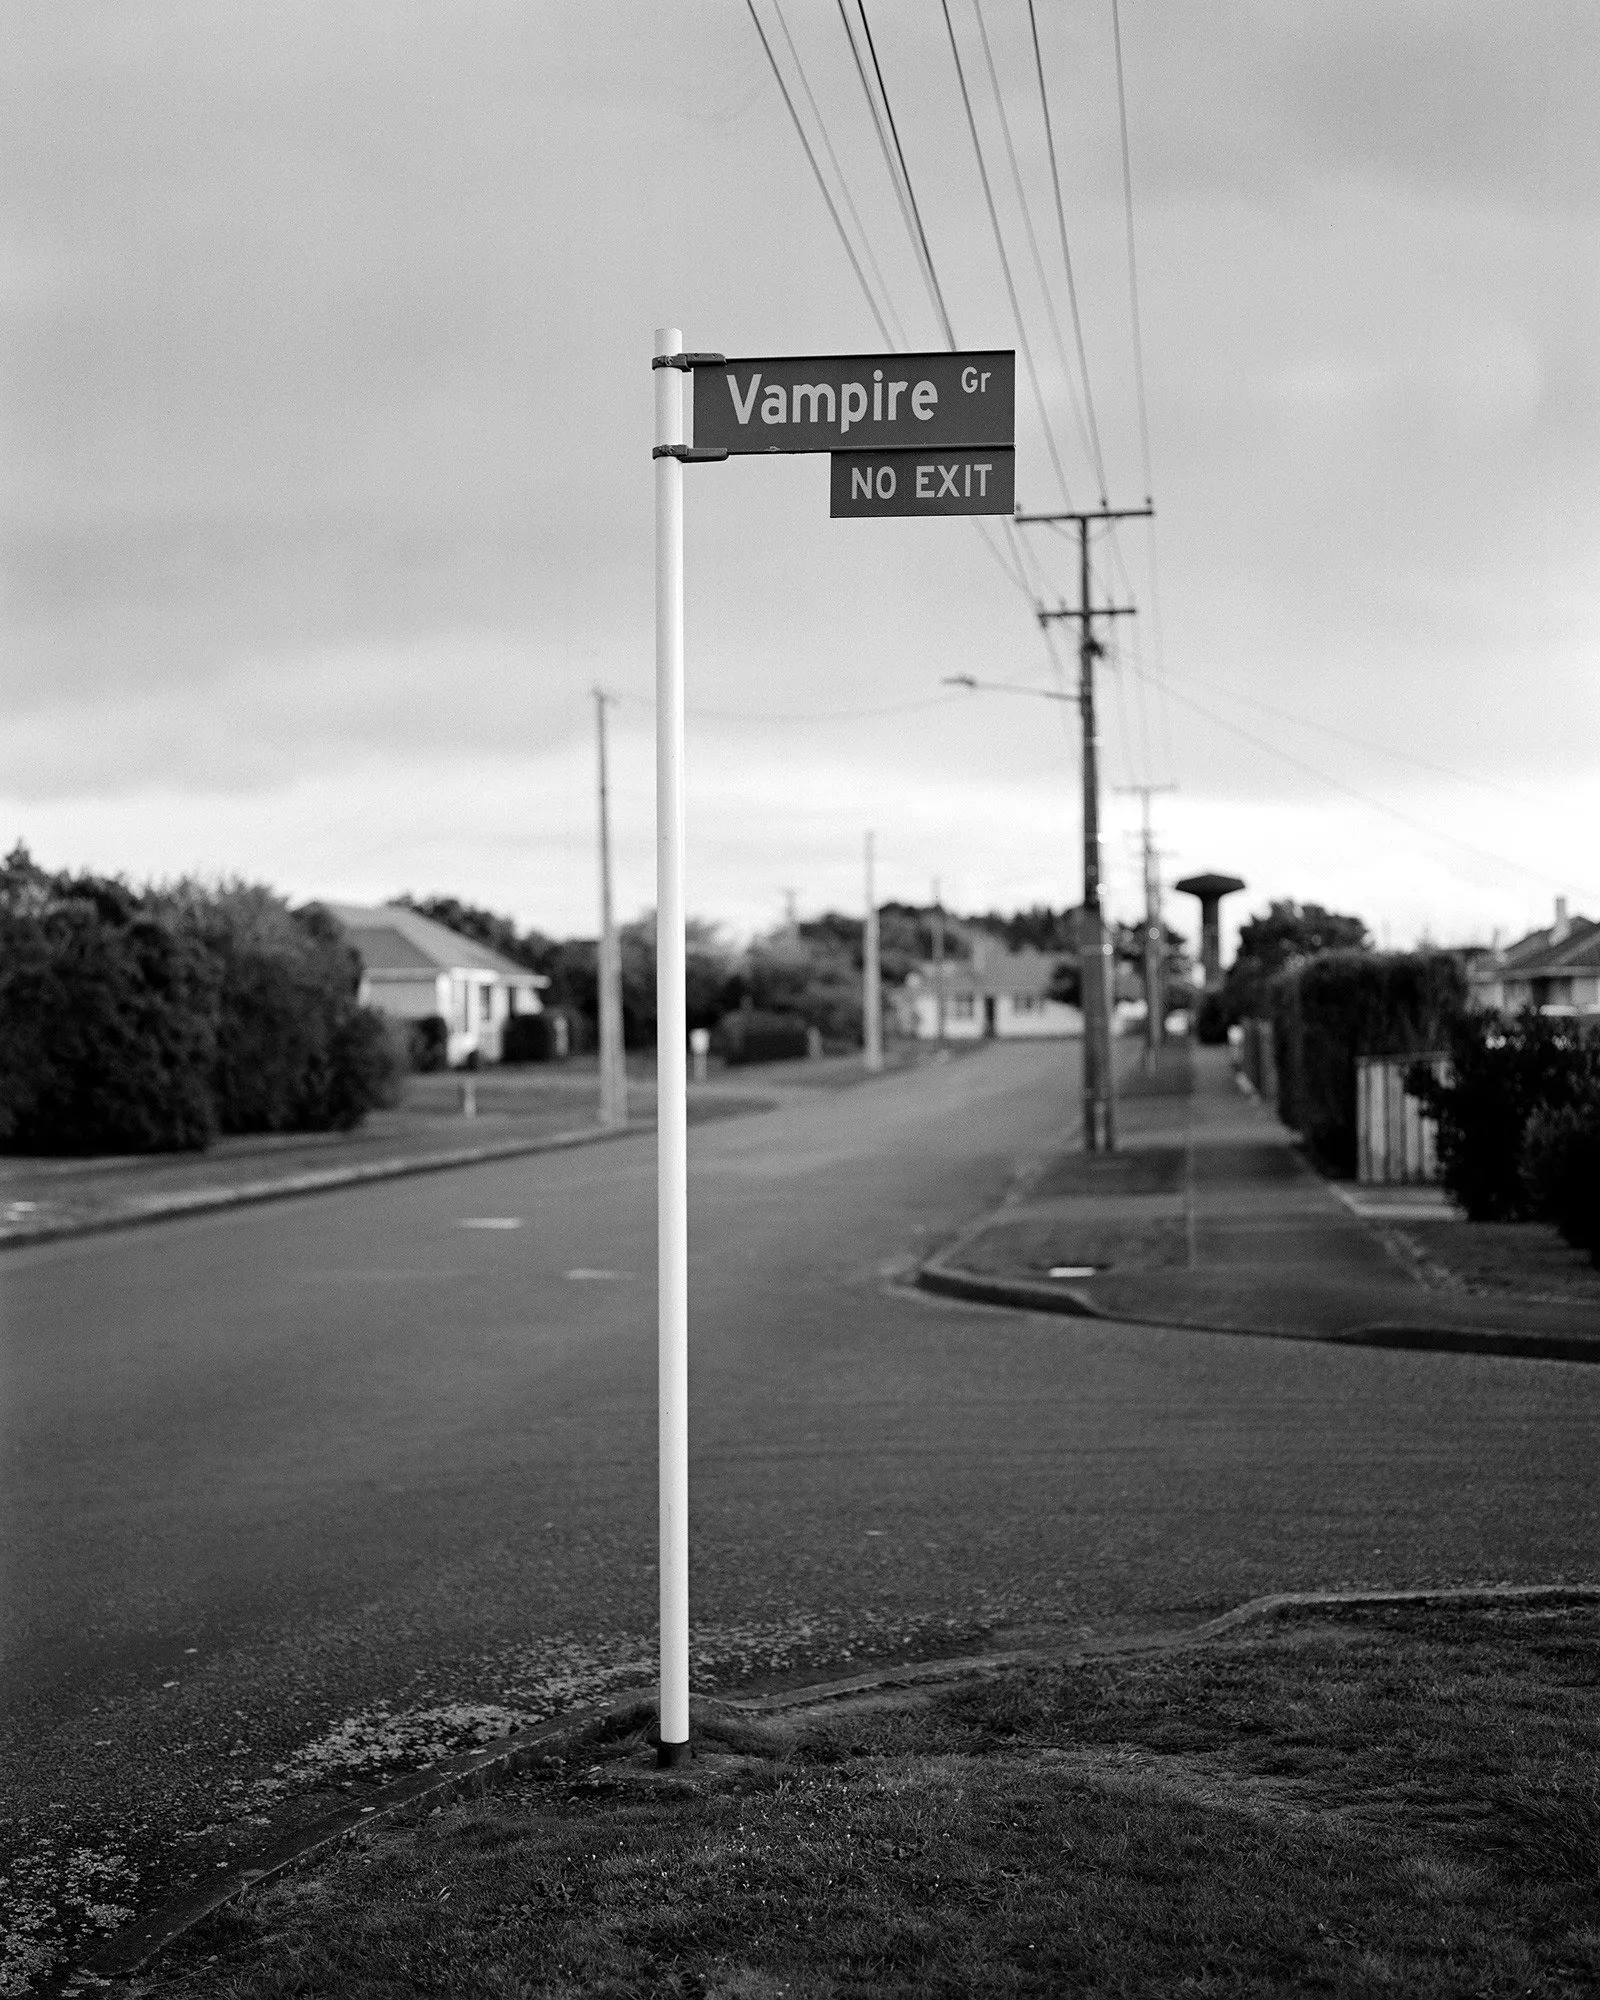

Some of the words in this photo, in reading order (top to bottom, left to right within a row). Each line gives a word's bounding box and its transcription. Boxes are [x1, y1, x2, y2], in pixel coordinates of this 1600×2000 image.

[726, 369, 939, 434] Vampire
[961, 366, 992, 394] Gr
[851, 465, 897, 500] NO
[915, 464, 993, 499] EXIT
